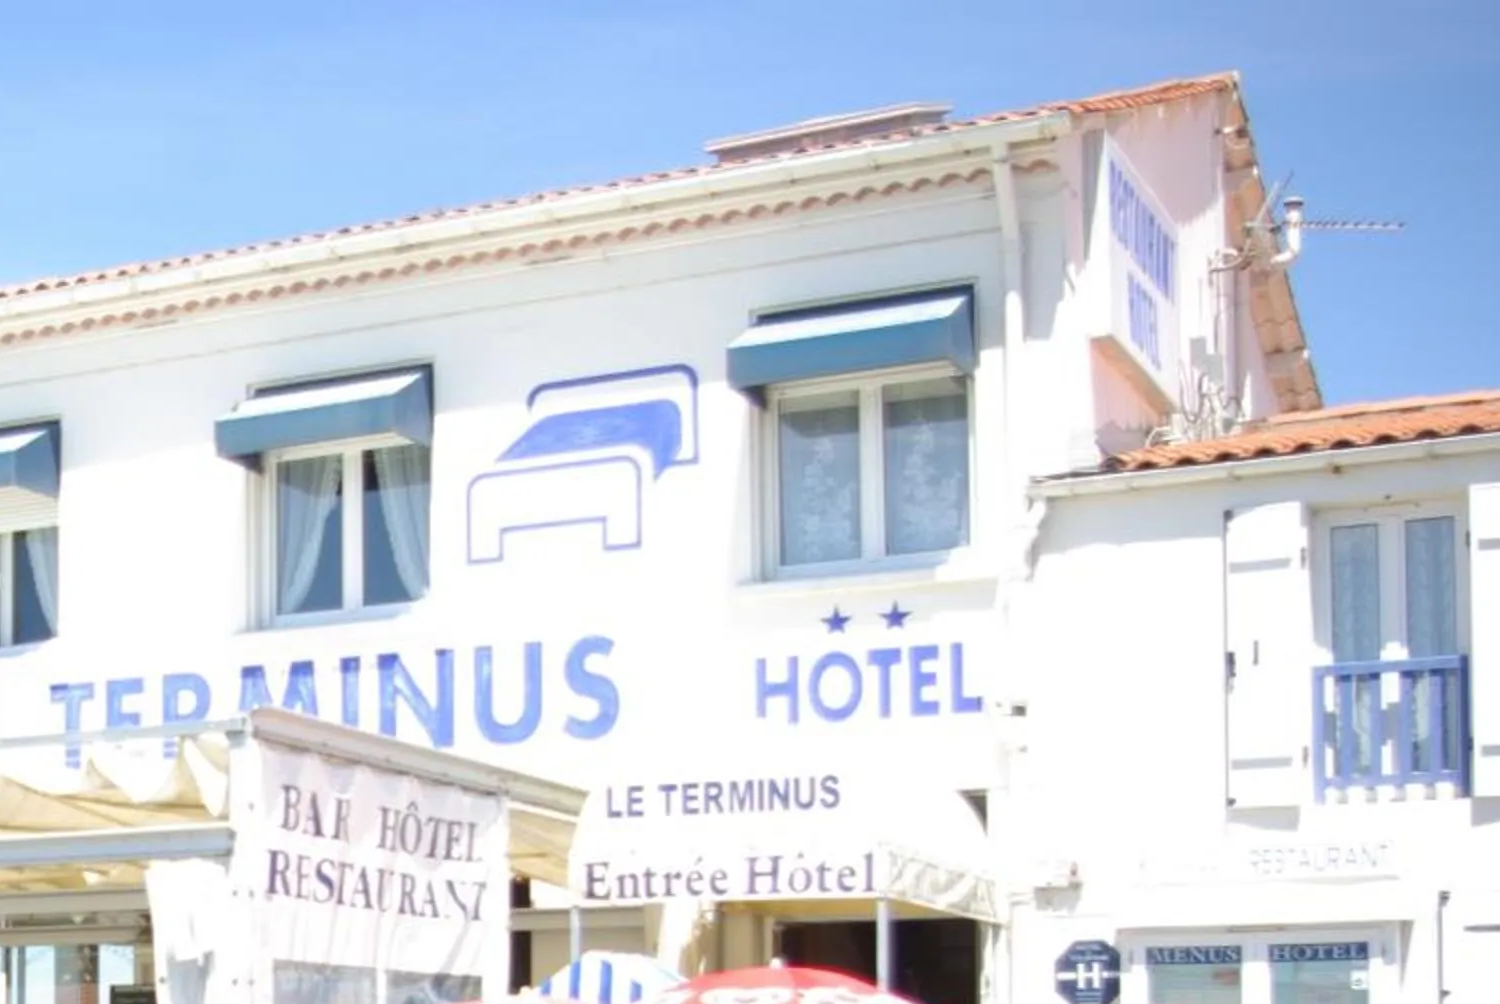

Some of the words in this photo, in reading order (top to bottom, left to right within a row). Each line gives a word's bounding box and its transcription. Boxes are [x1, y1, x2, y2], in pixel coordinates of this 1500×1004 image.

[755, 642, 984, 725] HOTEL
[606, 785, 645, 818] LE
[658, 774, 841, 816] TERMINUS
[584, 855, 729, 901] Entrée
[1153, 947, 1240, 964] MENUS
[1272, 943, 1366, 961] HOTEL
